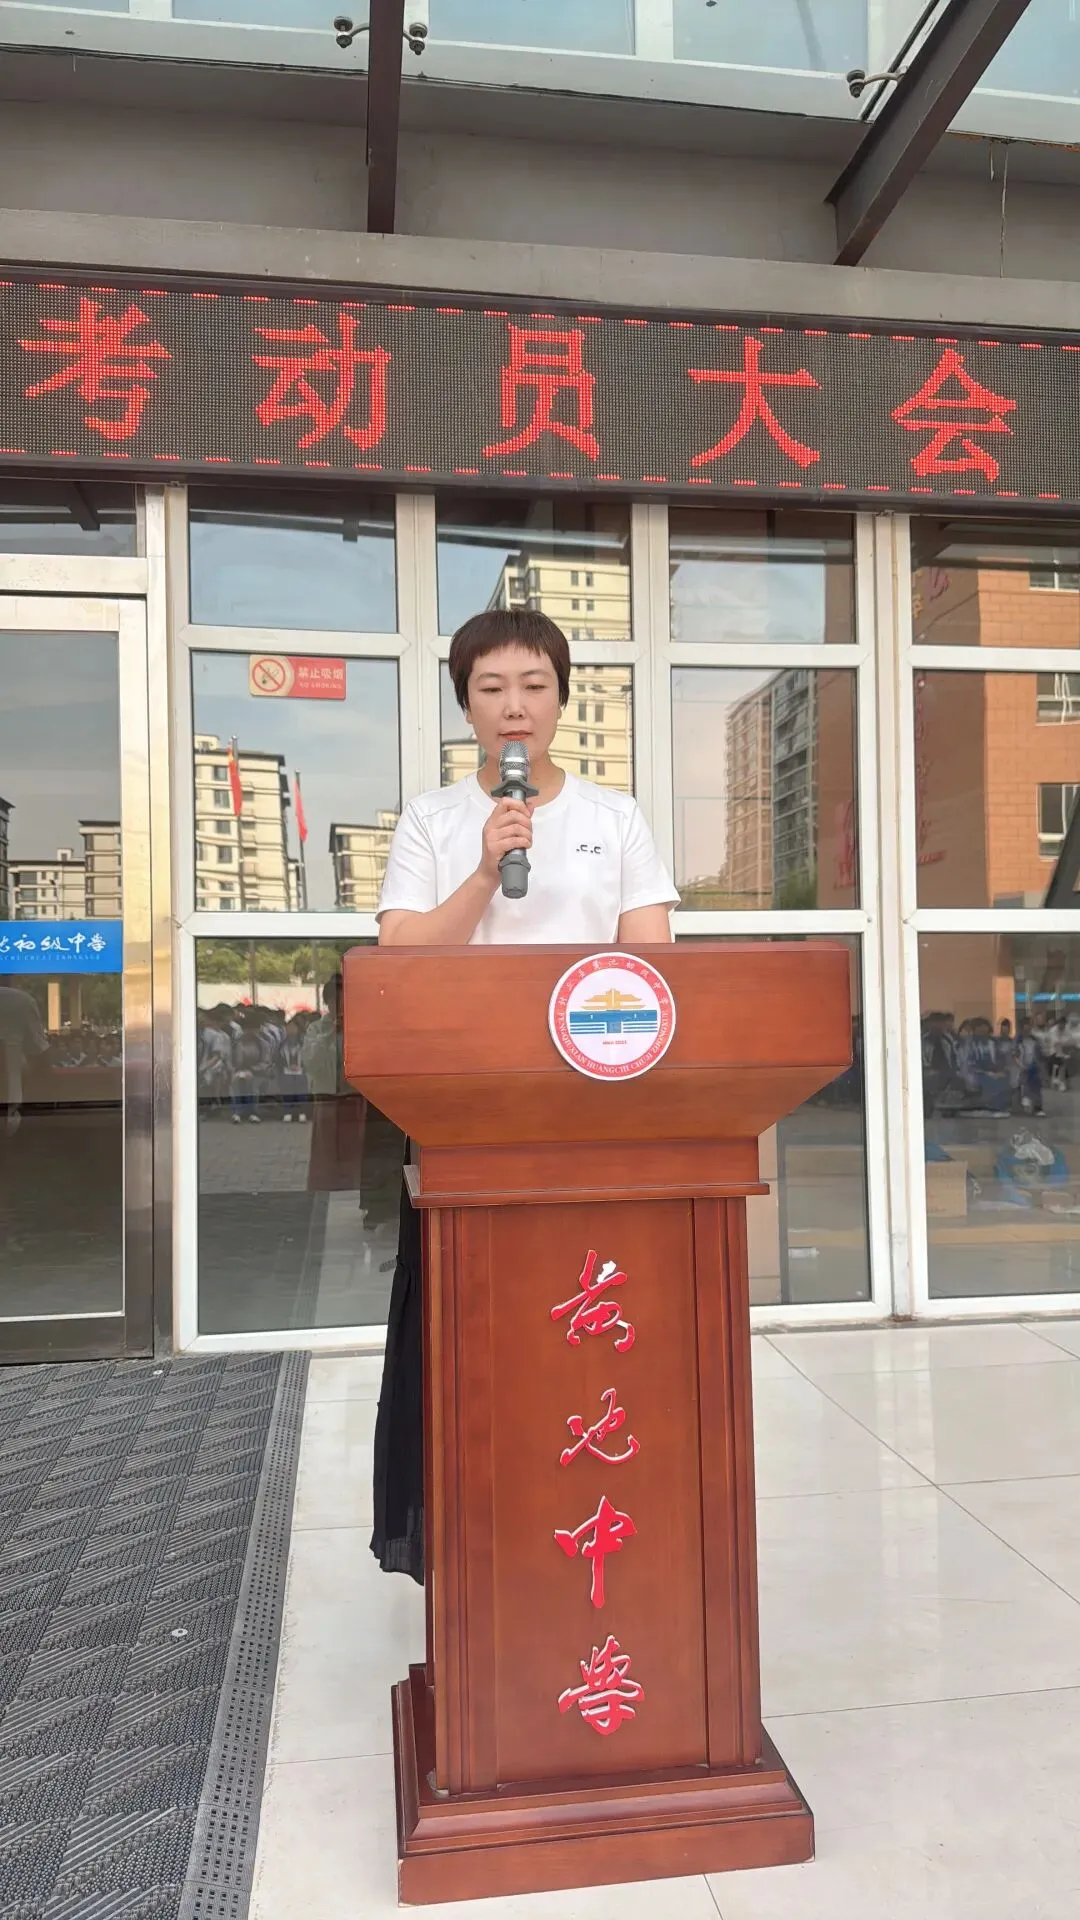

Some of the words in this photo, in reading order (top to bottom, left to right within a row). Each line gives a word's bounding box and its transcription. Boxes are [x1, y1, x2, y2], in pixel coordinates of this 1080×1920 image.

[17, 297, 1018, 482] 考动员大会
[298, 667, 344, 680] 禁止吸烟
